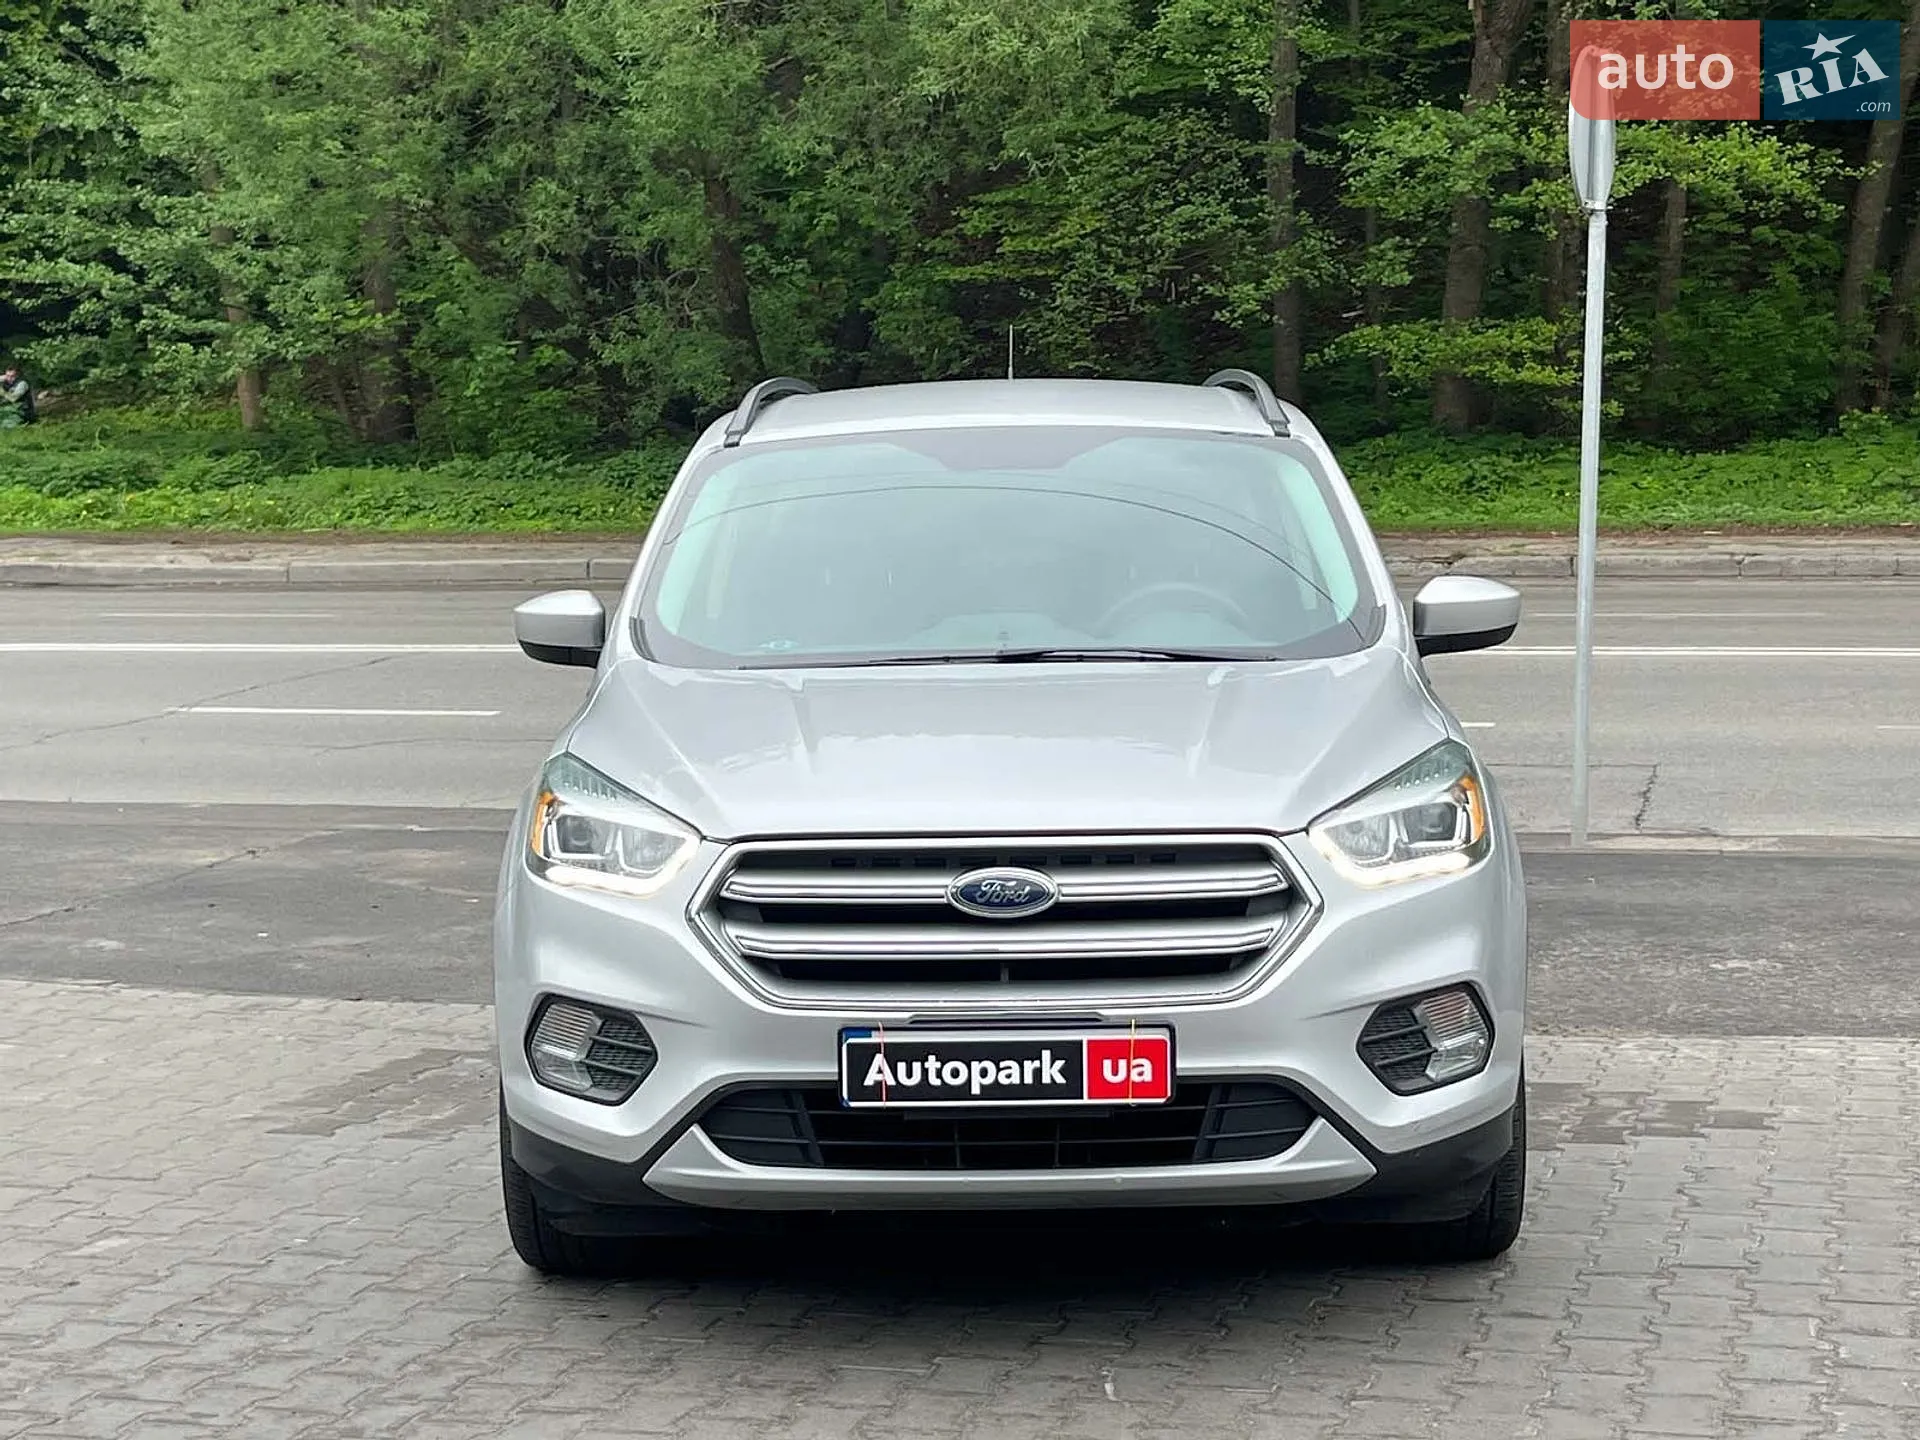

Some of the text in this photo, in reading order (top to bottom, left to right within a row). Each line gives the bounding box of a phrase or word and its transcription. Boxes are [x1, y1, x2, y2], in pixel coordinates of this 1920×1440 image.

[976, 880, 1031, 903] Ford
[863, 1050, 1153, 1095] Autopark ua
